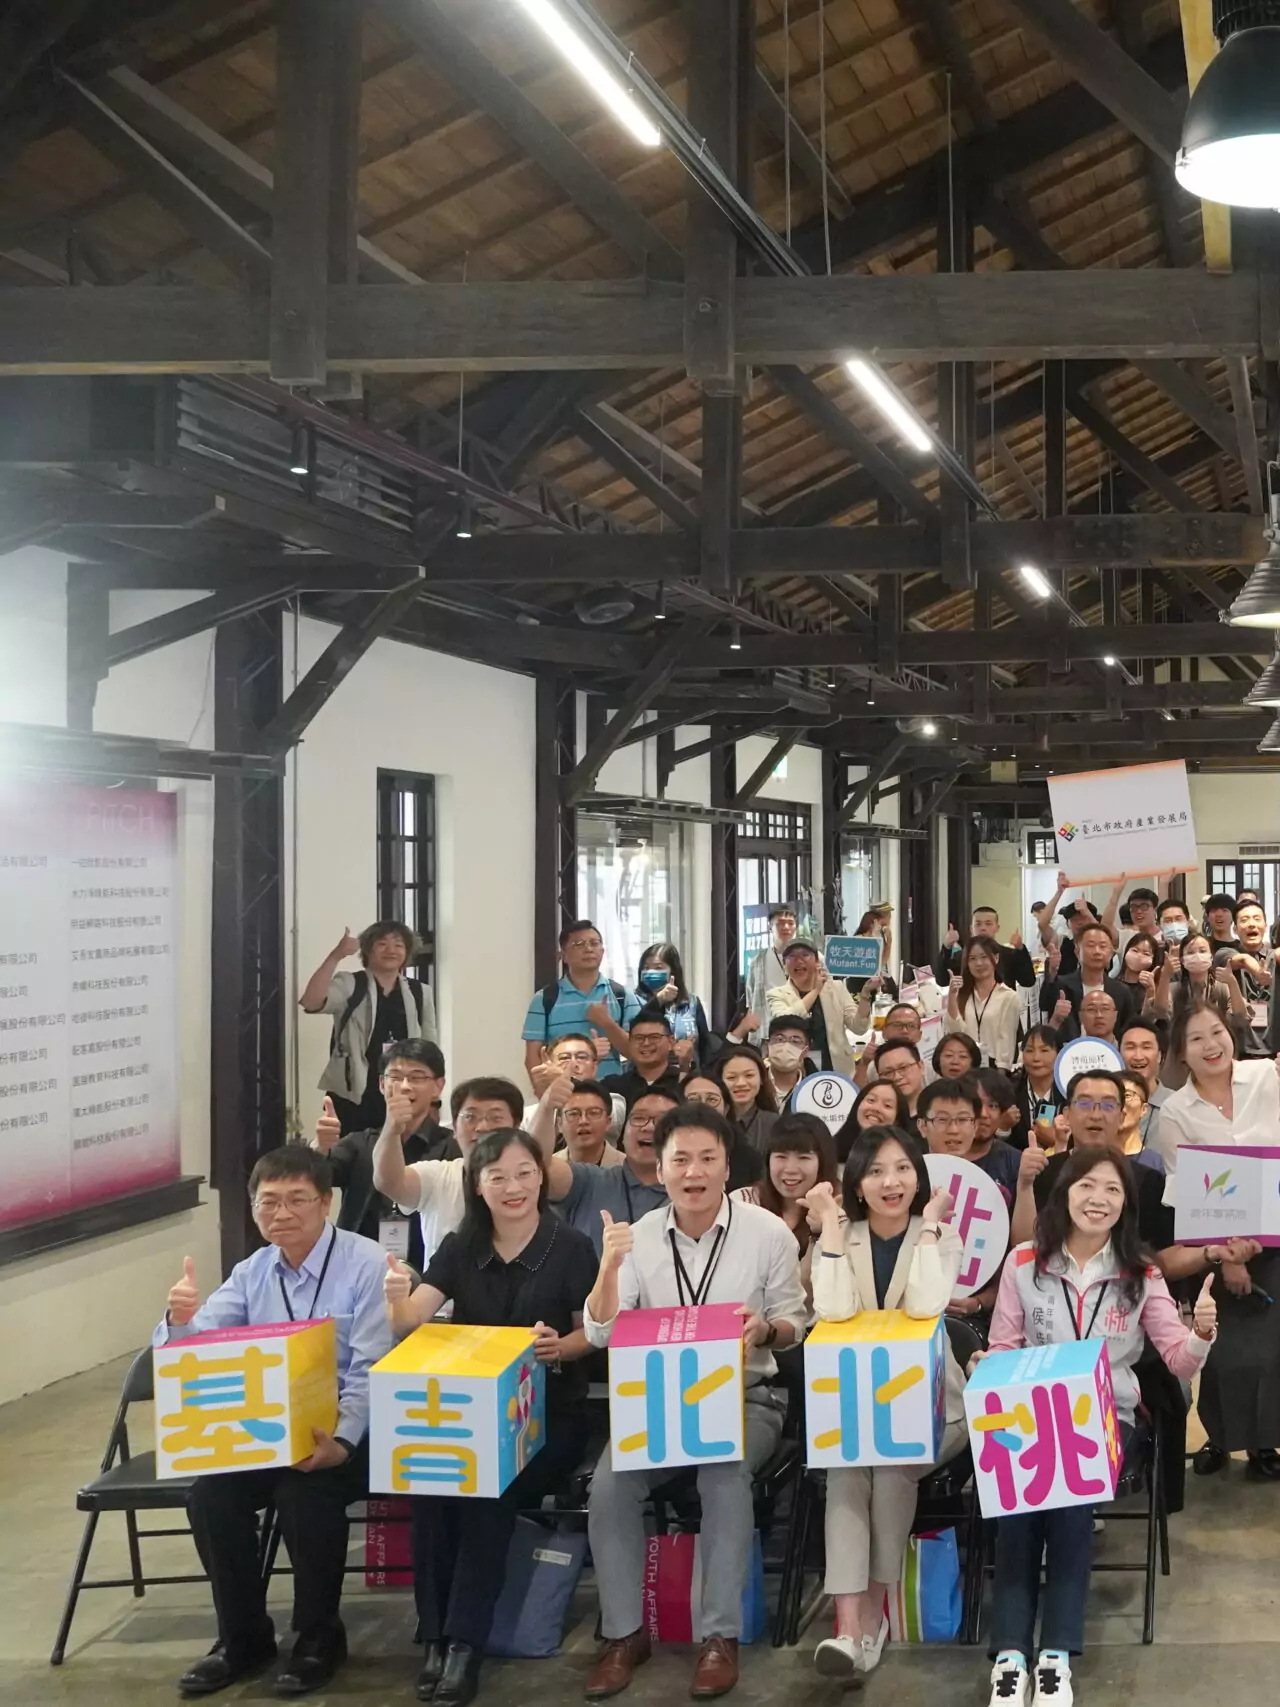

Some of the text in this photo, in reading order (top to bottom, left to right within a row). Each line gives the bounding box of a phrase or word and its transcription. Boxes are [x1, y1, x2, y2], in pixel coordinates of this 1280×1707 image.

[1083, 811, 1187, 835] 臺北市政府產業發展局
[830, 946, 877, 959] 牧天遊戲
[158, 1346, 287, 1471] 基
[391, 1377, 477, 1494] 青
[616, 1347, 735, 1464] 北
[811, 1346, 926, 1462] 北
[972, 1382, 1105, 1511] 桃
[376, 1534, 386, 1586] AFFARS
[647, 1535, 660, 1583] YOUTH
